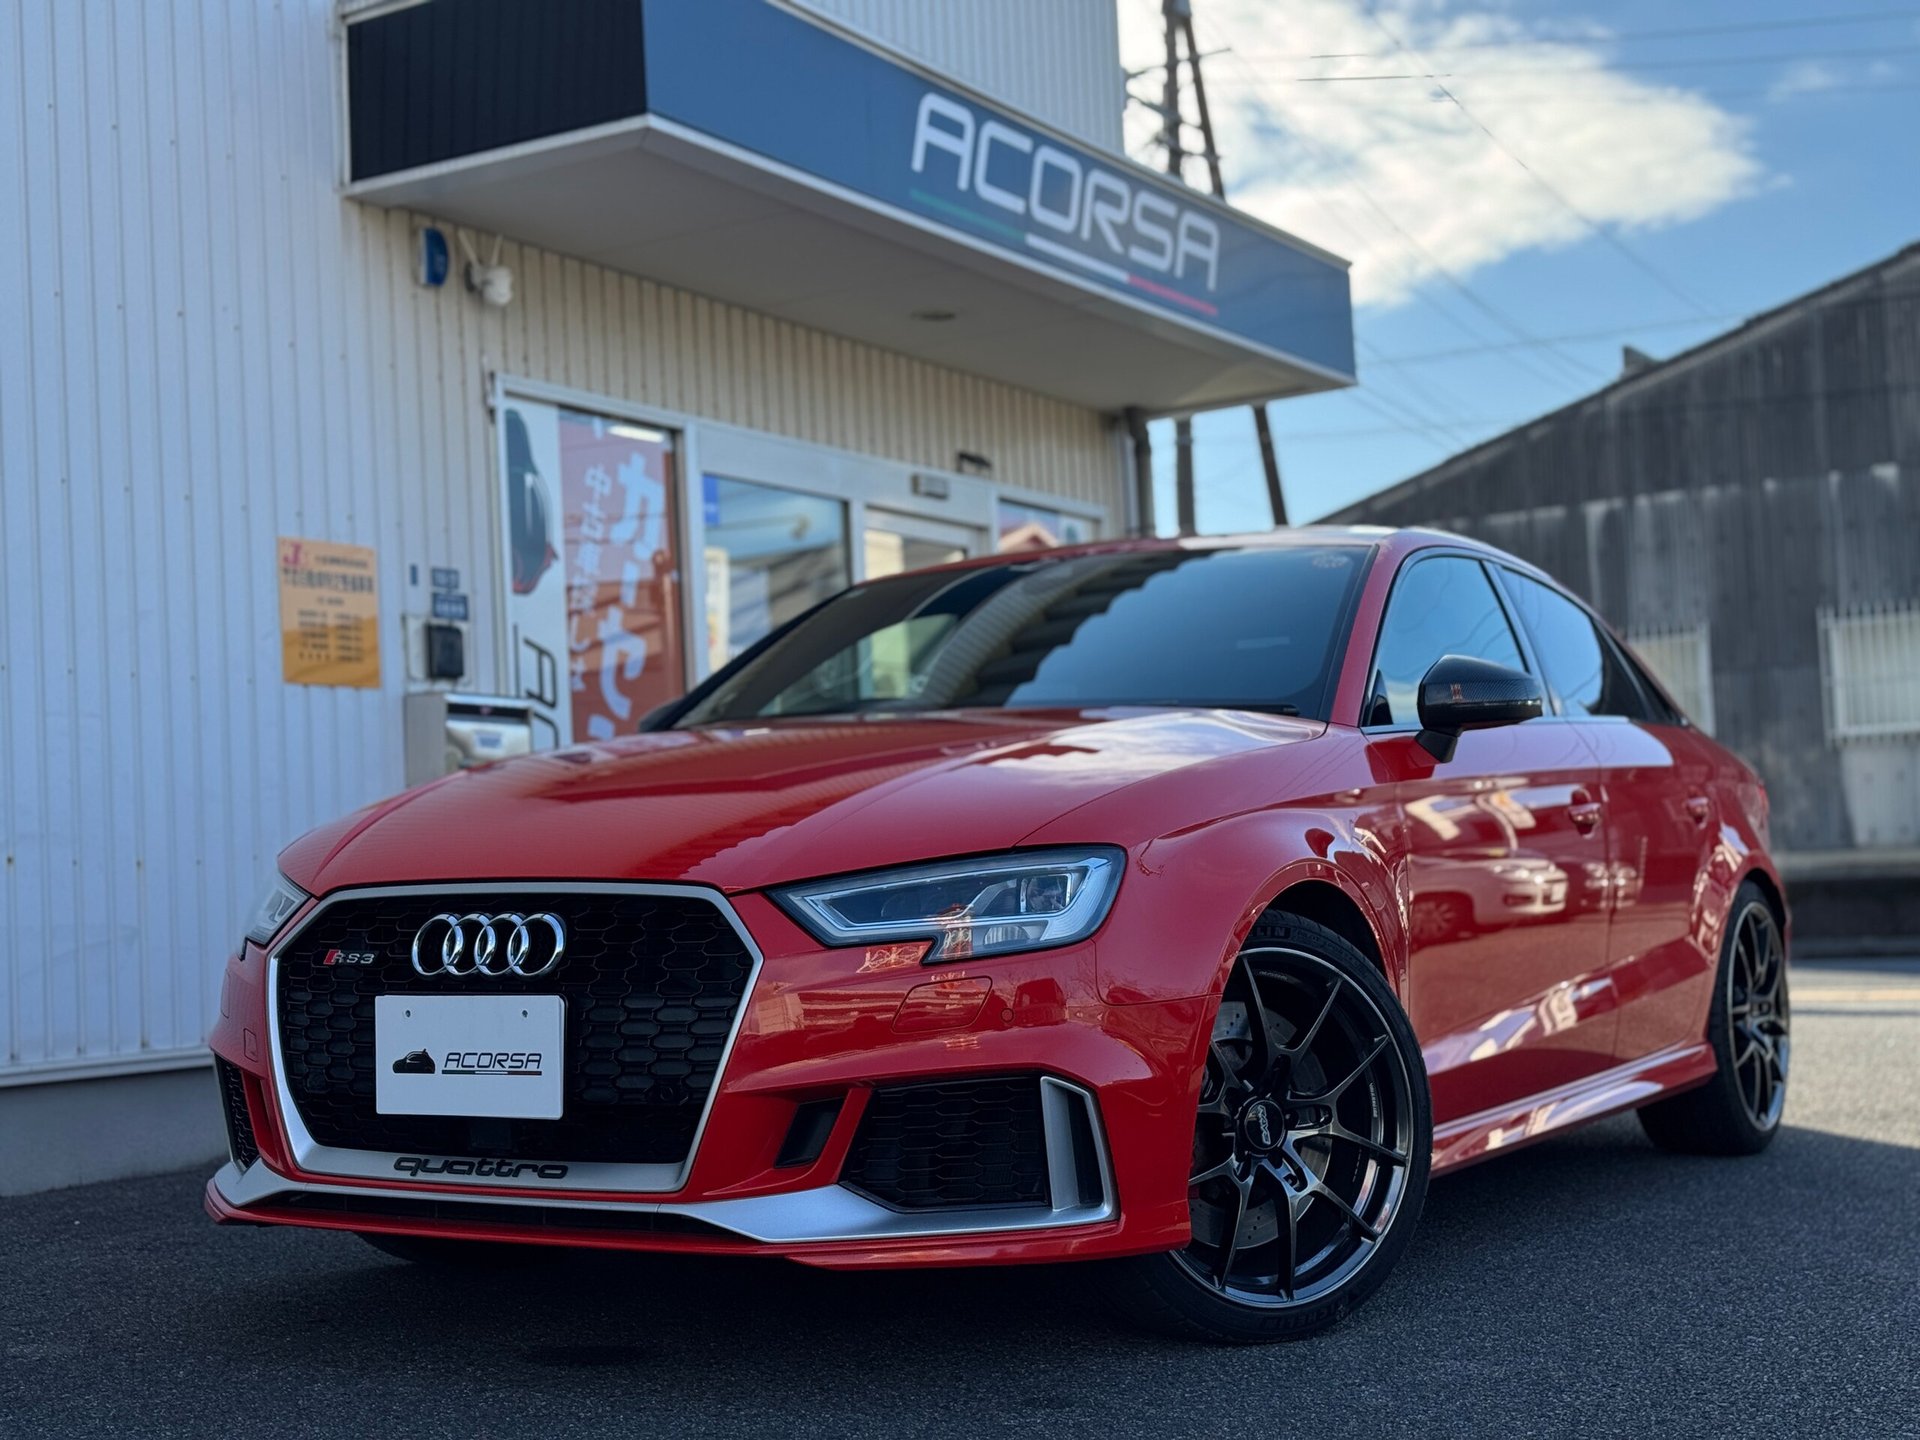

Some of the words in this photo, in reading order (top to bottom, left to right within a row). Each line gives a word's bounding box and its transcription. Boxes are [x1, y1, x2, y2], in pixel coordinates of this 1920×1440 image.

[911, 92, 1219, 291] ACORSA
[588, 450, 665, 740] カーセ
[444, 1053, 542, 1069] ACORSA
[393, 1155, 569, 1179] quattro
